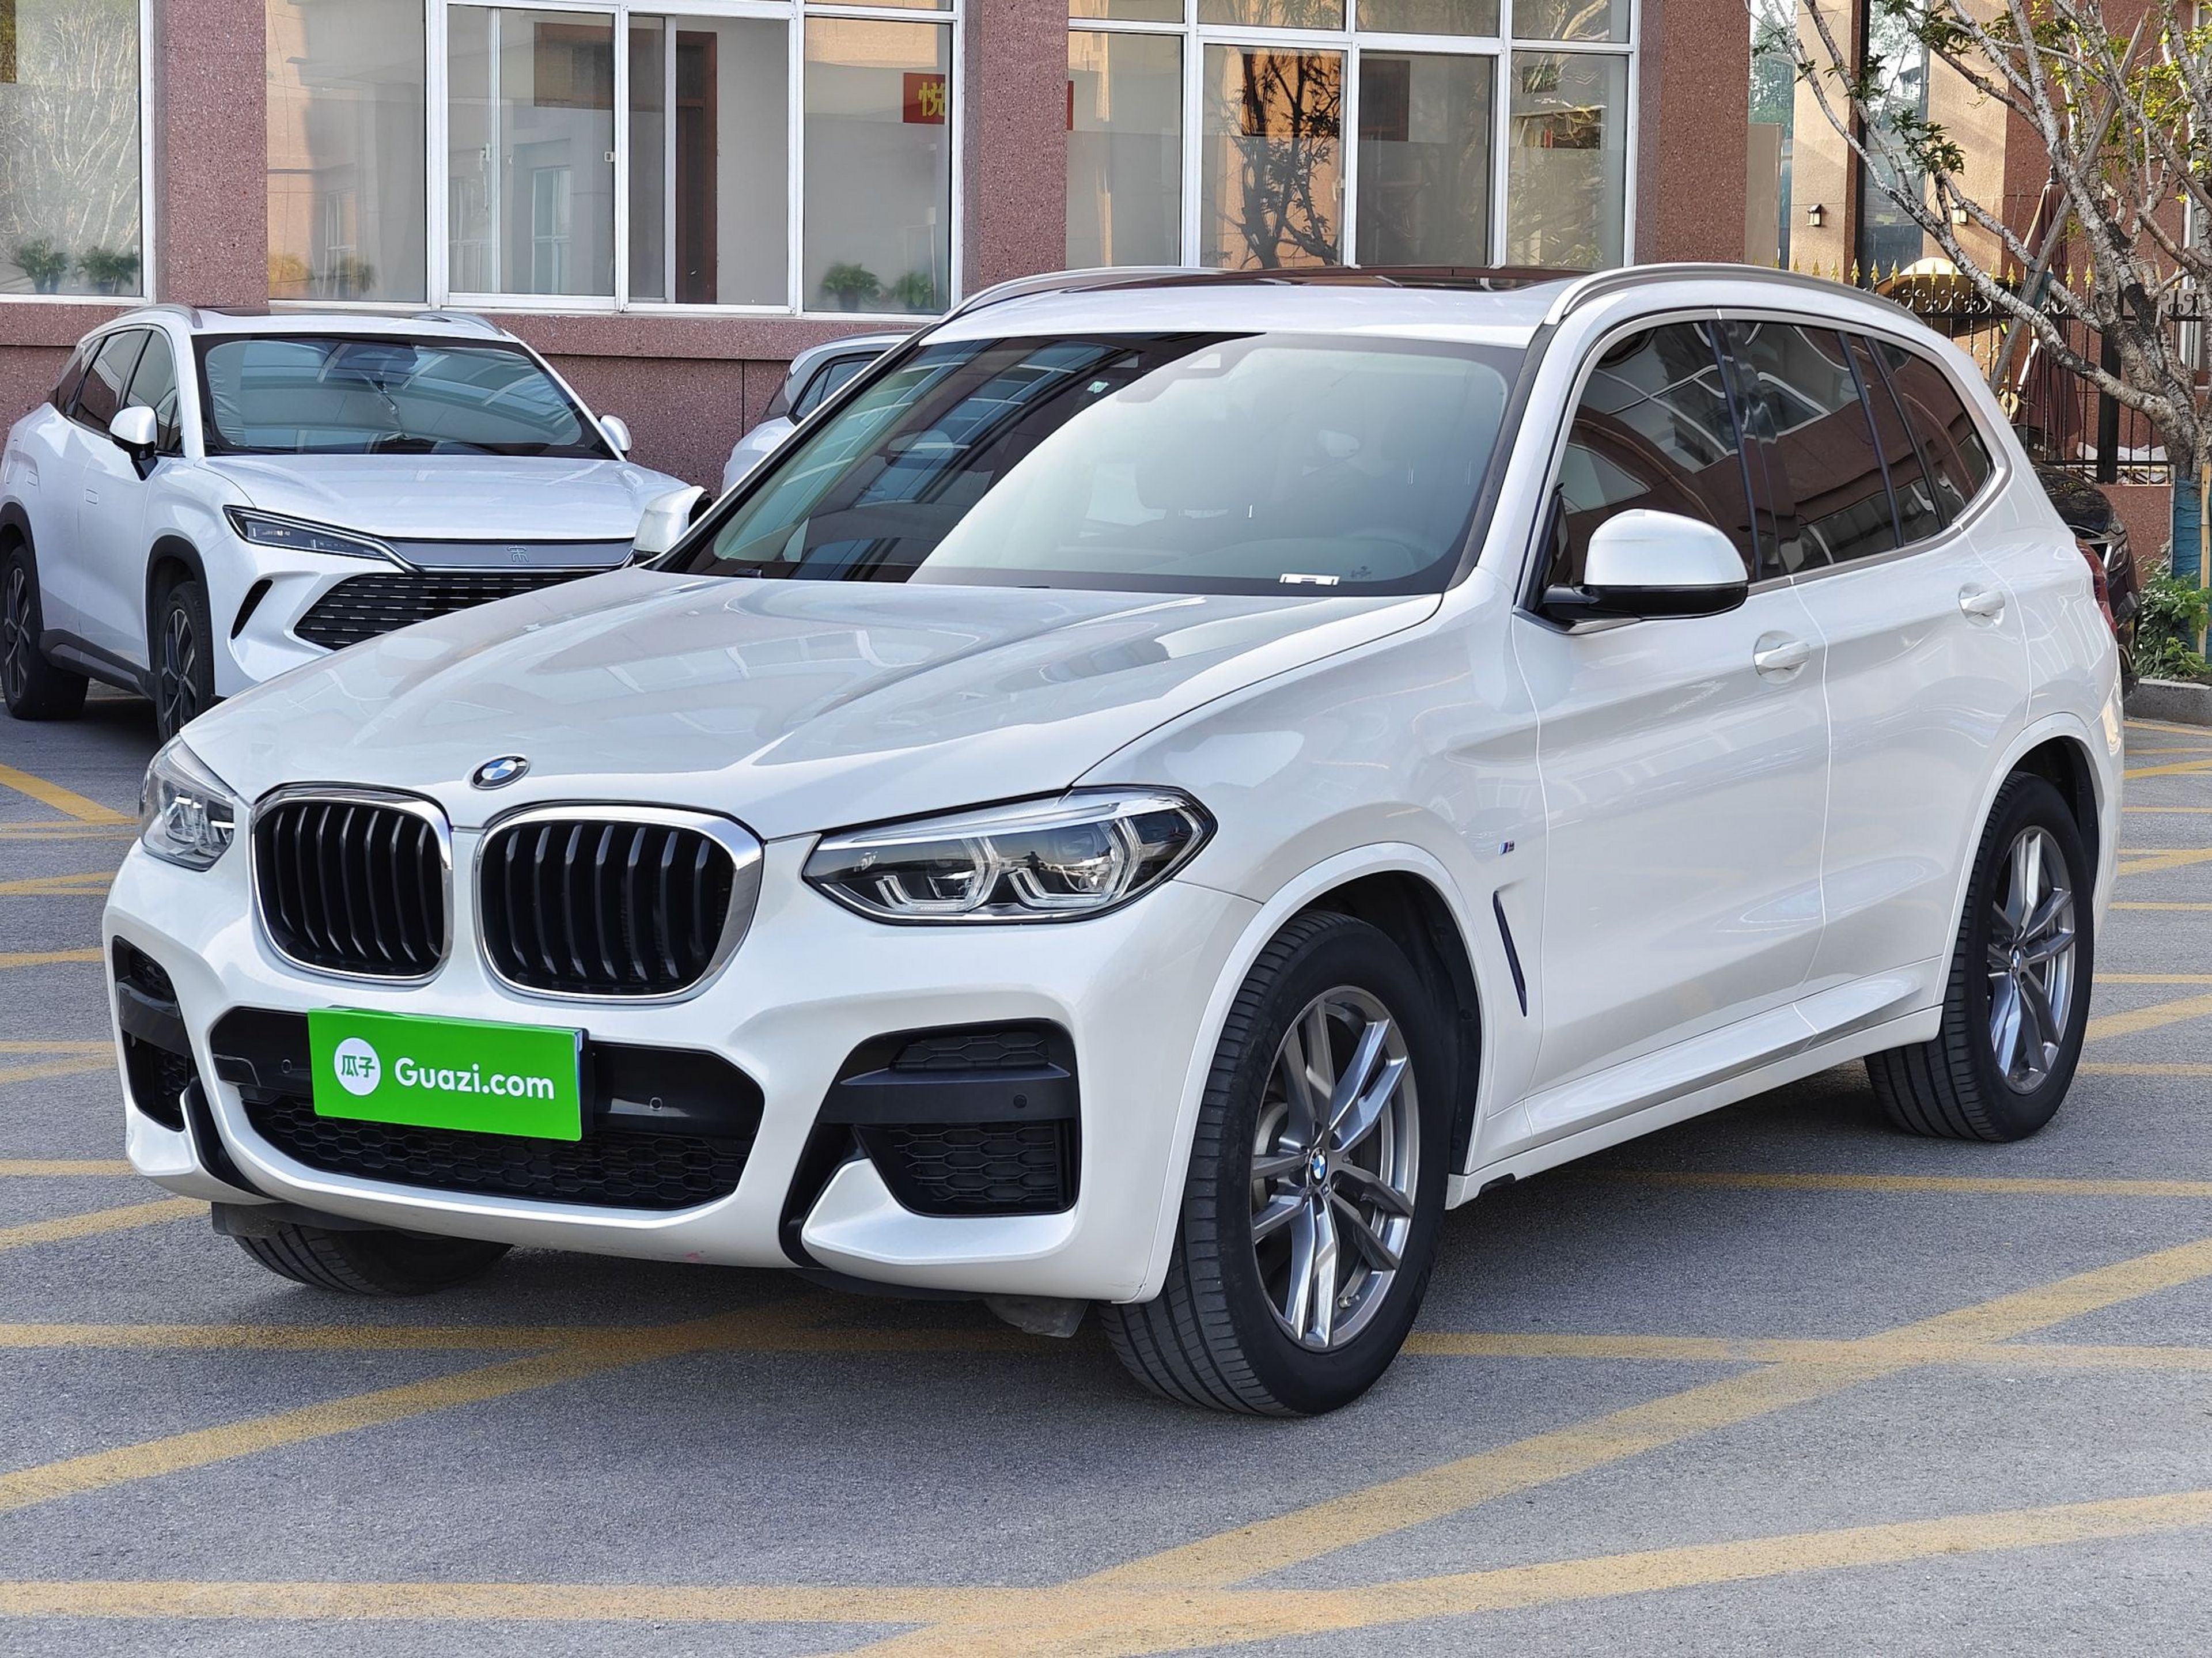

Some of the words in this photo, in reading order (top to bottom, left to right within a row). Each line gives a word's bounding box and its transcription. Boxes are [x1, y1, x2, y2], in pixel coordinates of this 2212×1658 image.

[918, 82, 945, 116] 悦
[341, 1055, 375, 1078] 瓜子
[395, 1057, 555, 1100] Guazi.com
